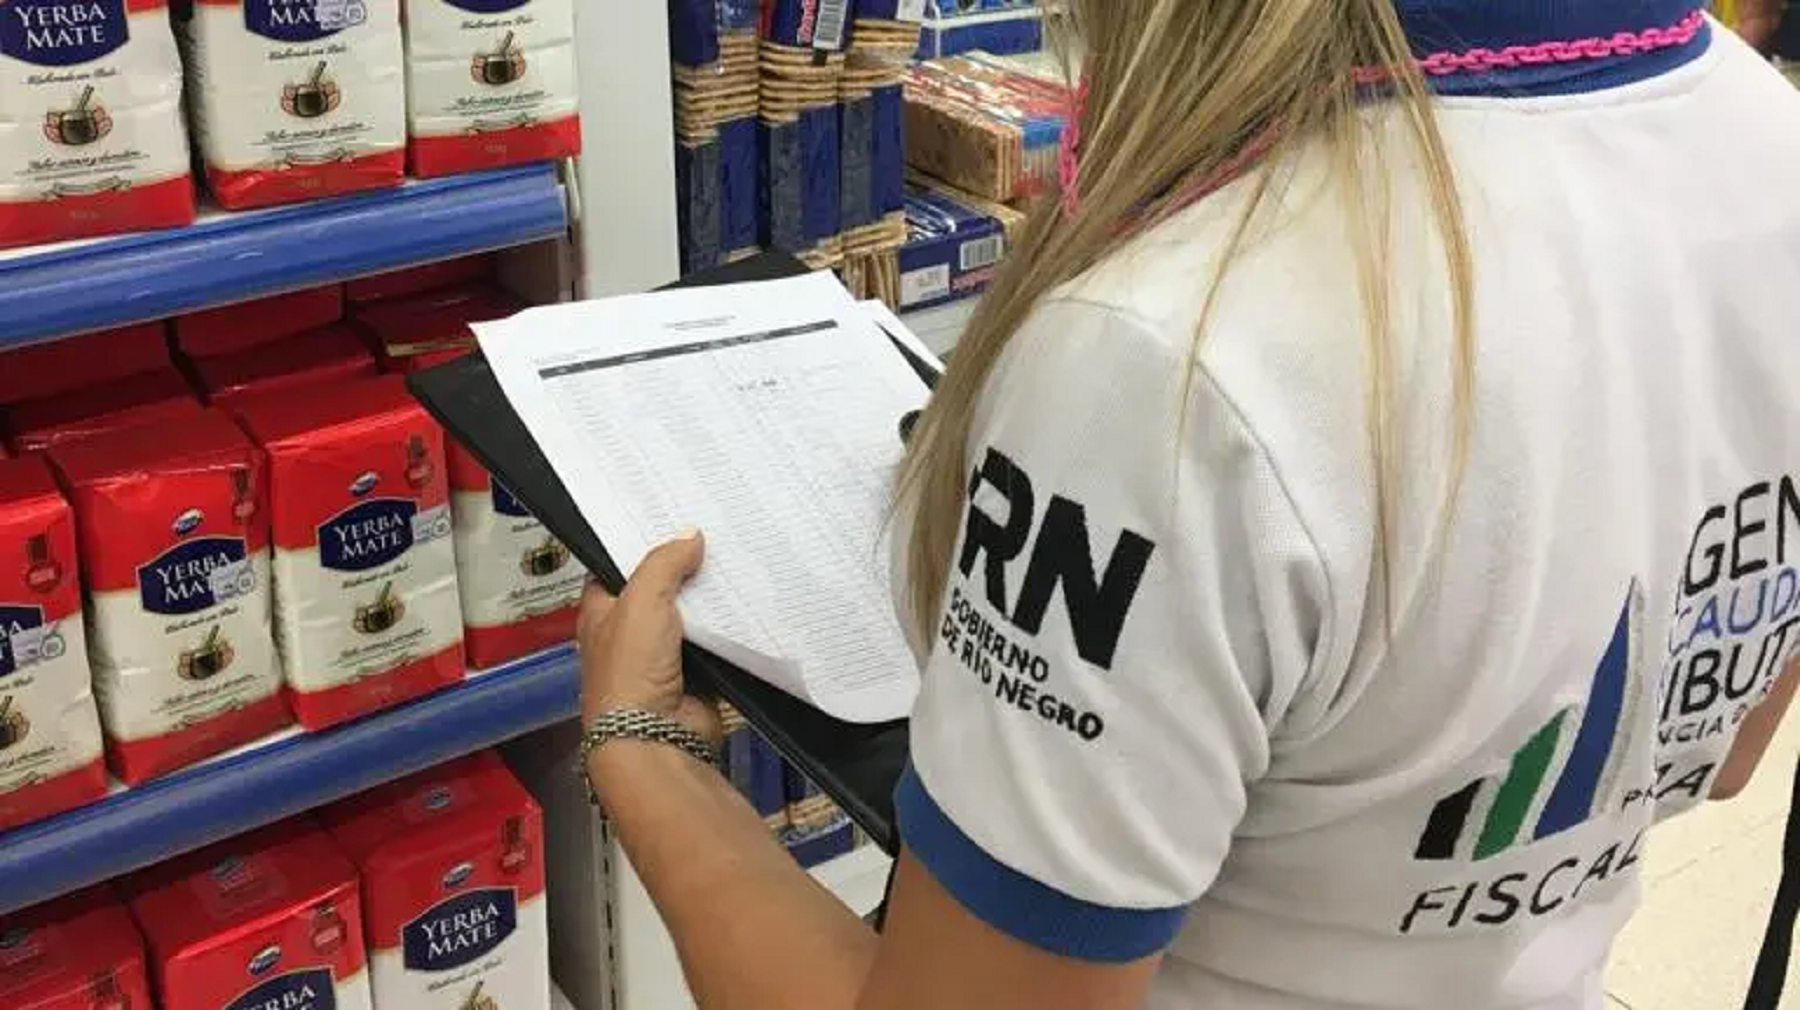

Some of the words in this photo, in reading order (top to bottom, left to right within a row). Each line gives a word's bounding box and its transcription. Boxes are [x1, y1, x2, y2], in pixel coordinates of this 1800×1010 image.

[15, 2, 106, 27] YERBA
[26, 25, 105, 50] MATE
[334, 513, 404, 542] YERBA
[341, 531, 402, 560] MATE
[958, 446, 1156, 672] RN
[156, 552, 231, 585] YERBA
[995, 672, 1104, 742] NEGRO
[421, 902, 499, 941] YERBA
[428, 920, 498, 961] MATE
